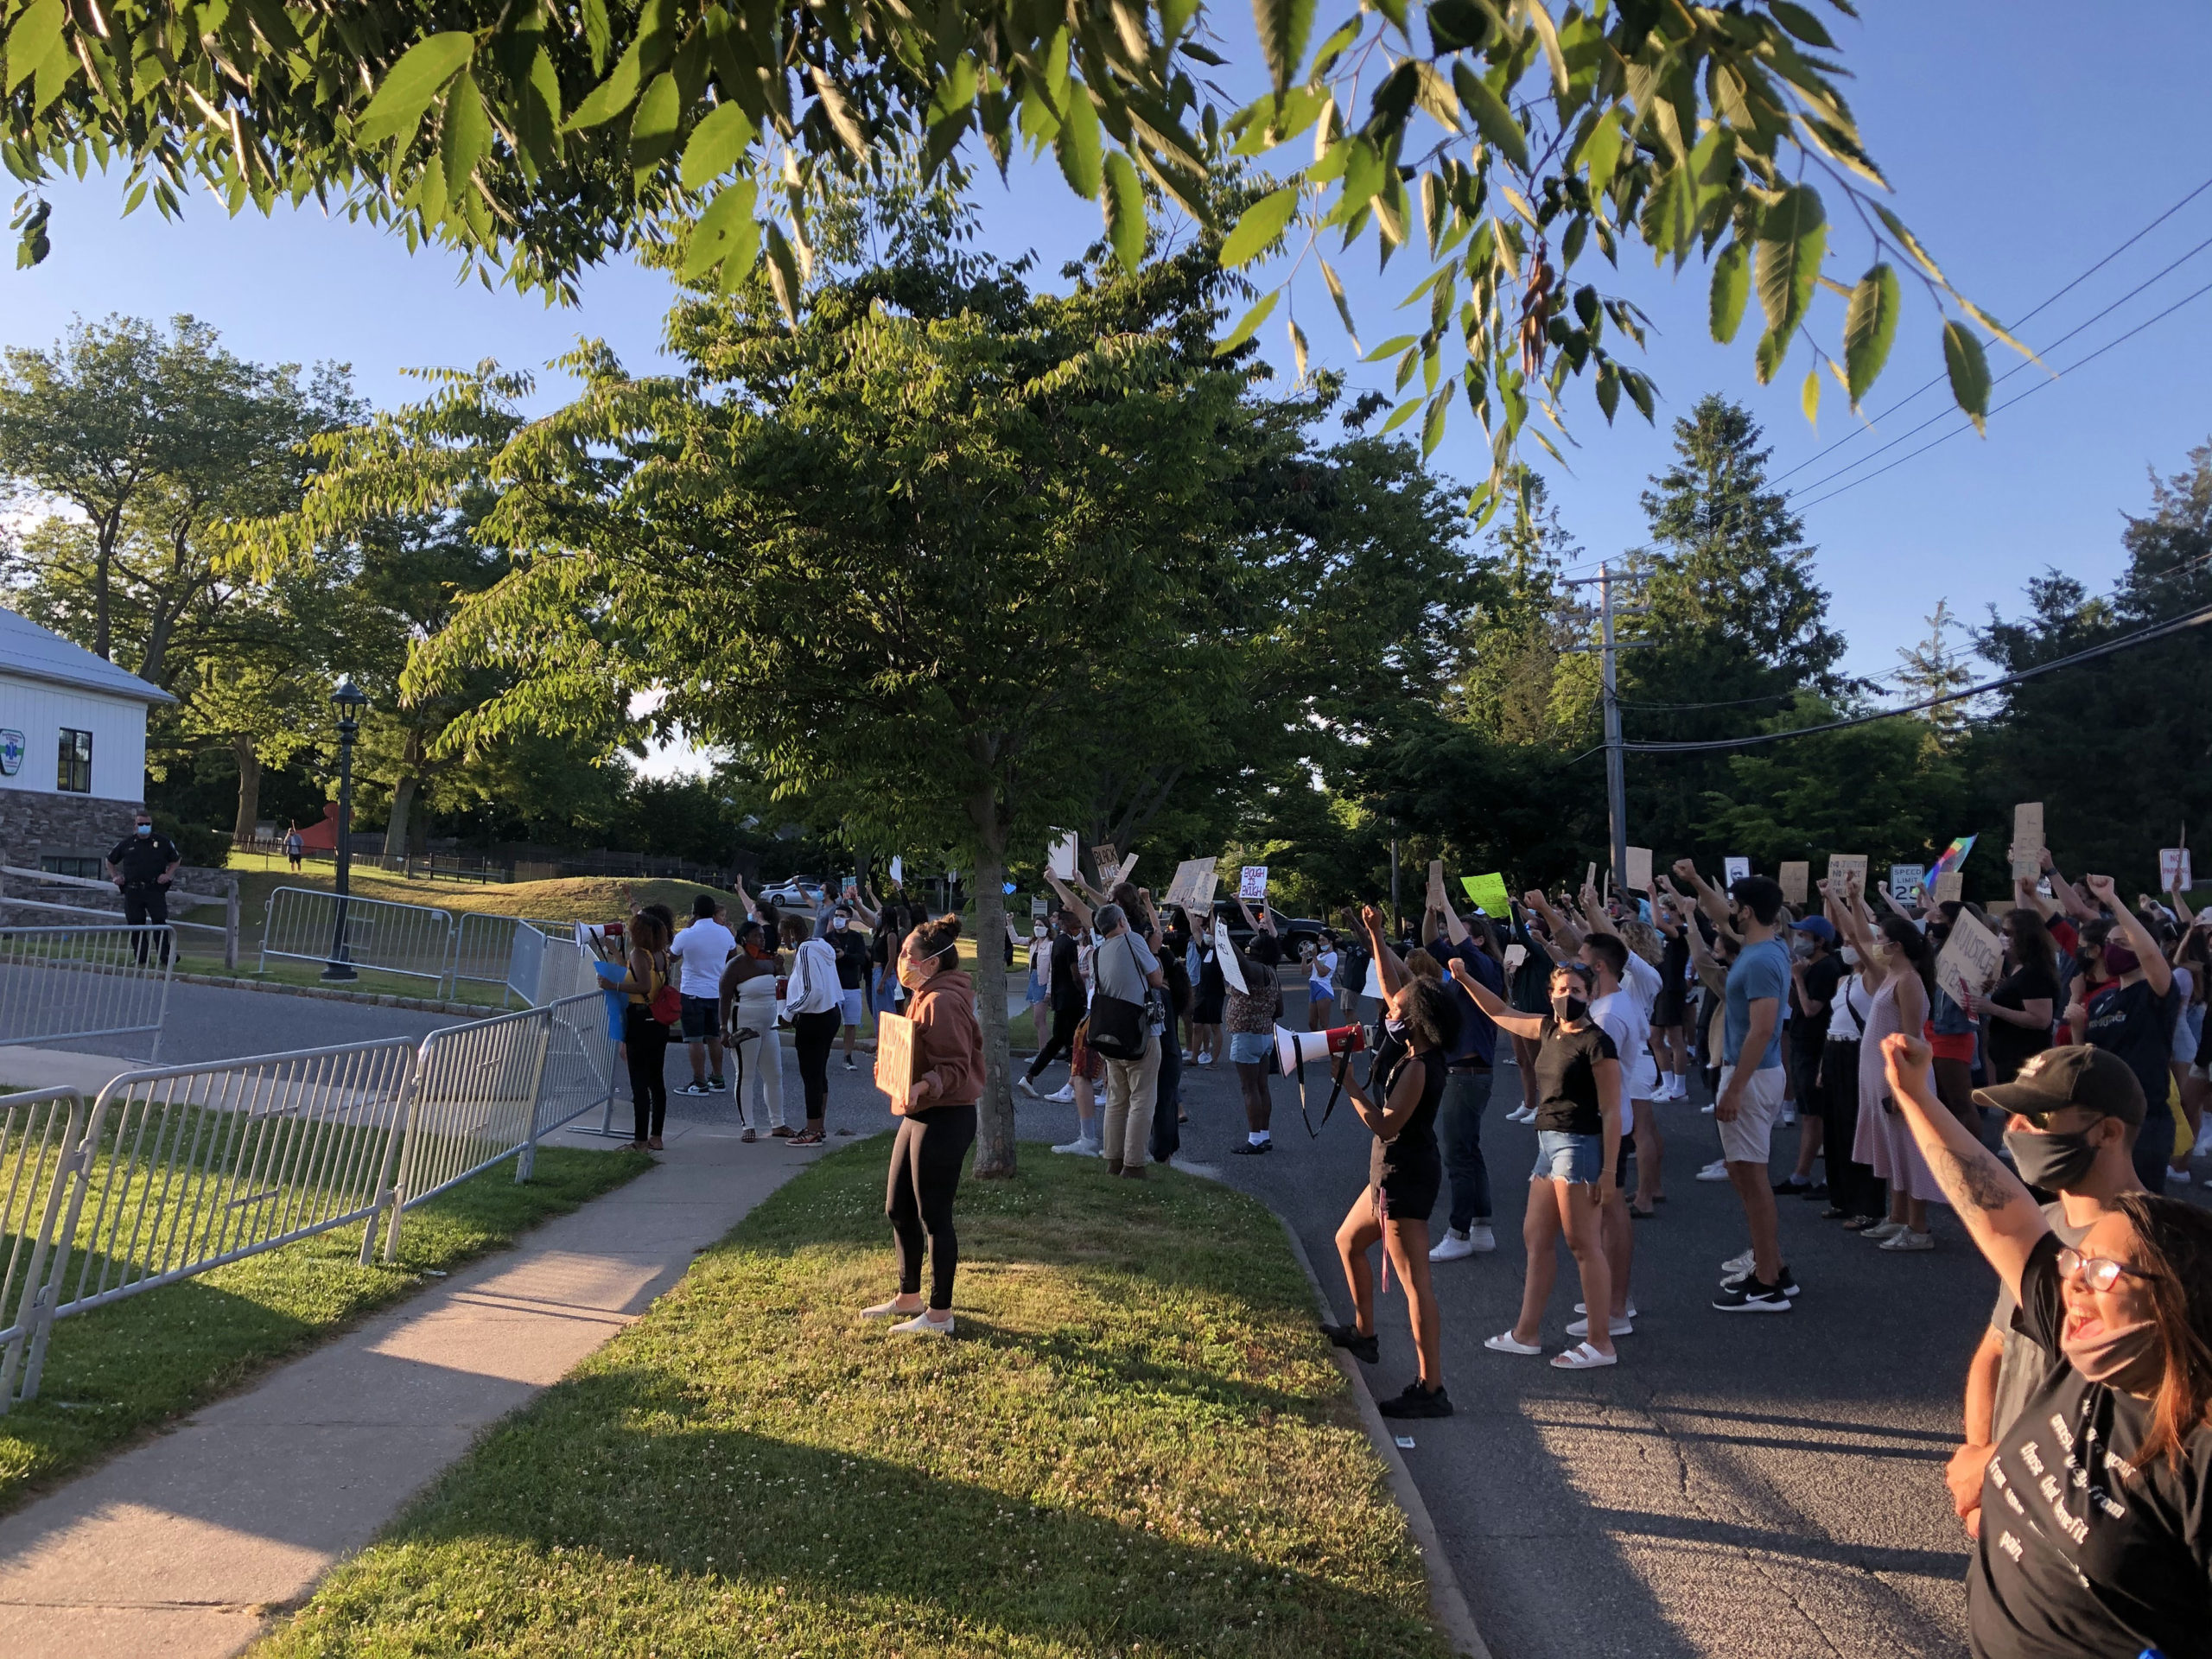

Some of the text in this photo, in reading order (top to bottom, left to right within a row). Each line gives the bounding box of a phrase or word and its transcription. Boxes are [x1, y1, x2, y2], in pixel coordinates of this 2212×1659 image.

[1094, 849, 1117, 866] BLACK
[2171, 855, 2181, 863] NO
[1248, 877, 1256, 886] IS
[1833, 869, 1842, 878] NO
[1987, 1455, 2007, 1490] from
[2018, 1440, 2044, 1478] those
[2039, 1474, 2062, 1503] that
[2052, 1496, 2089, 1546] benefit
[2088, 1484, 2125, 1520] from
